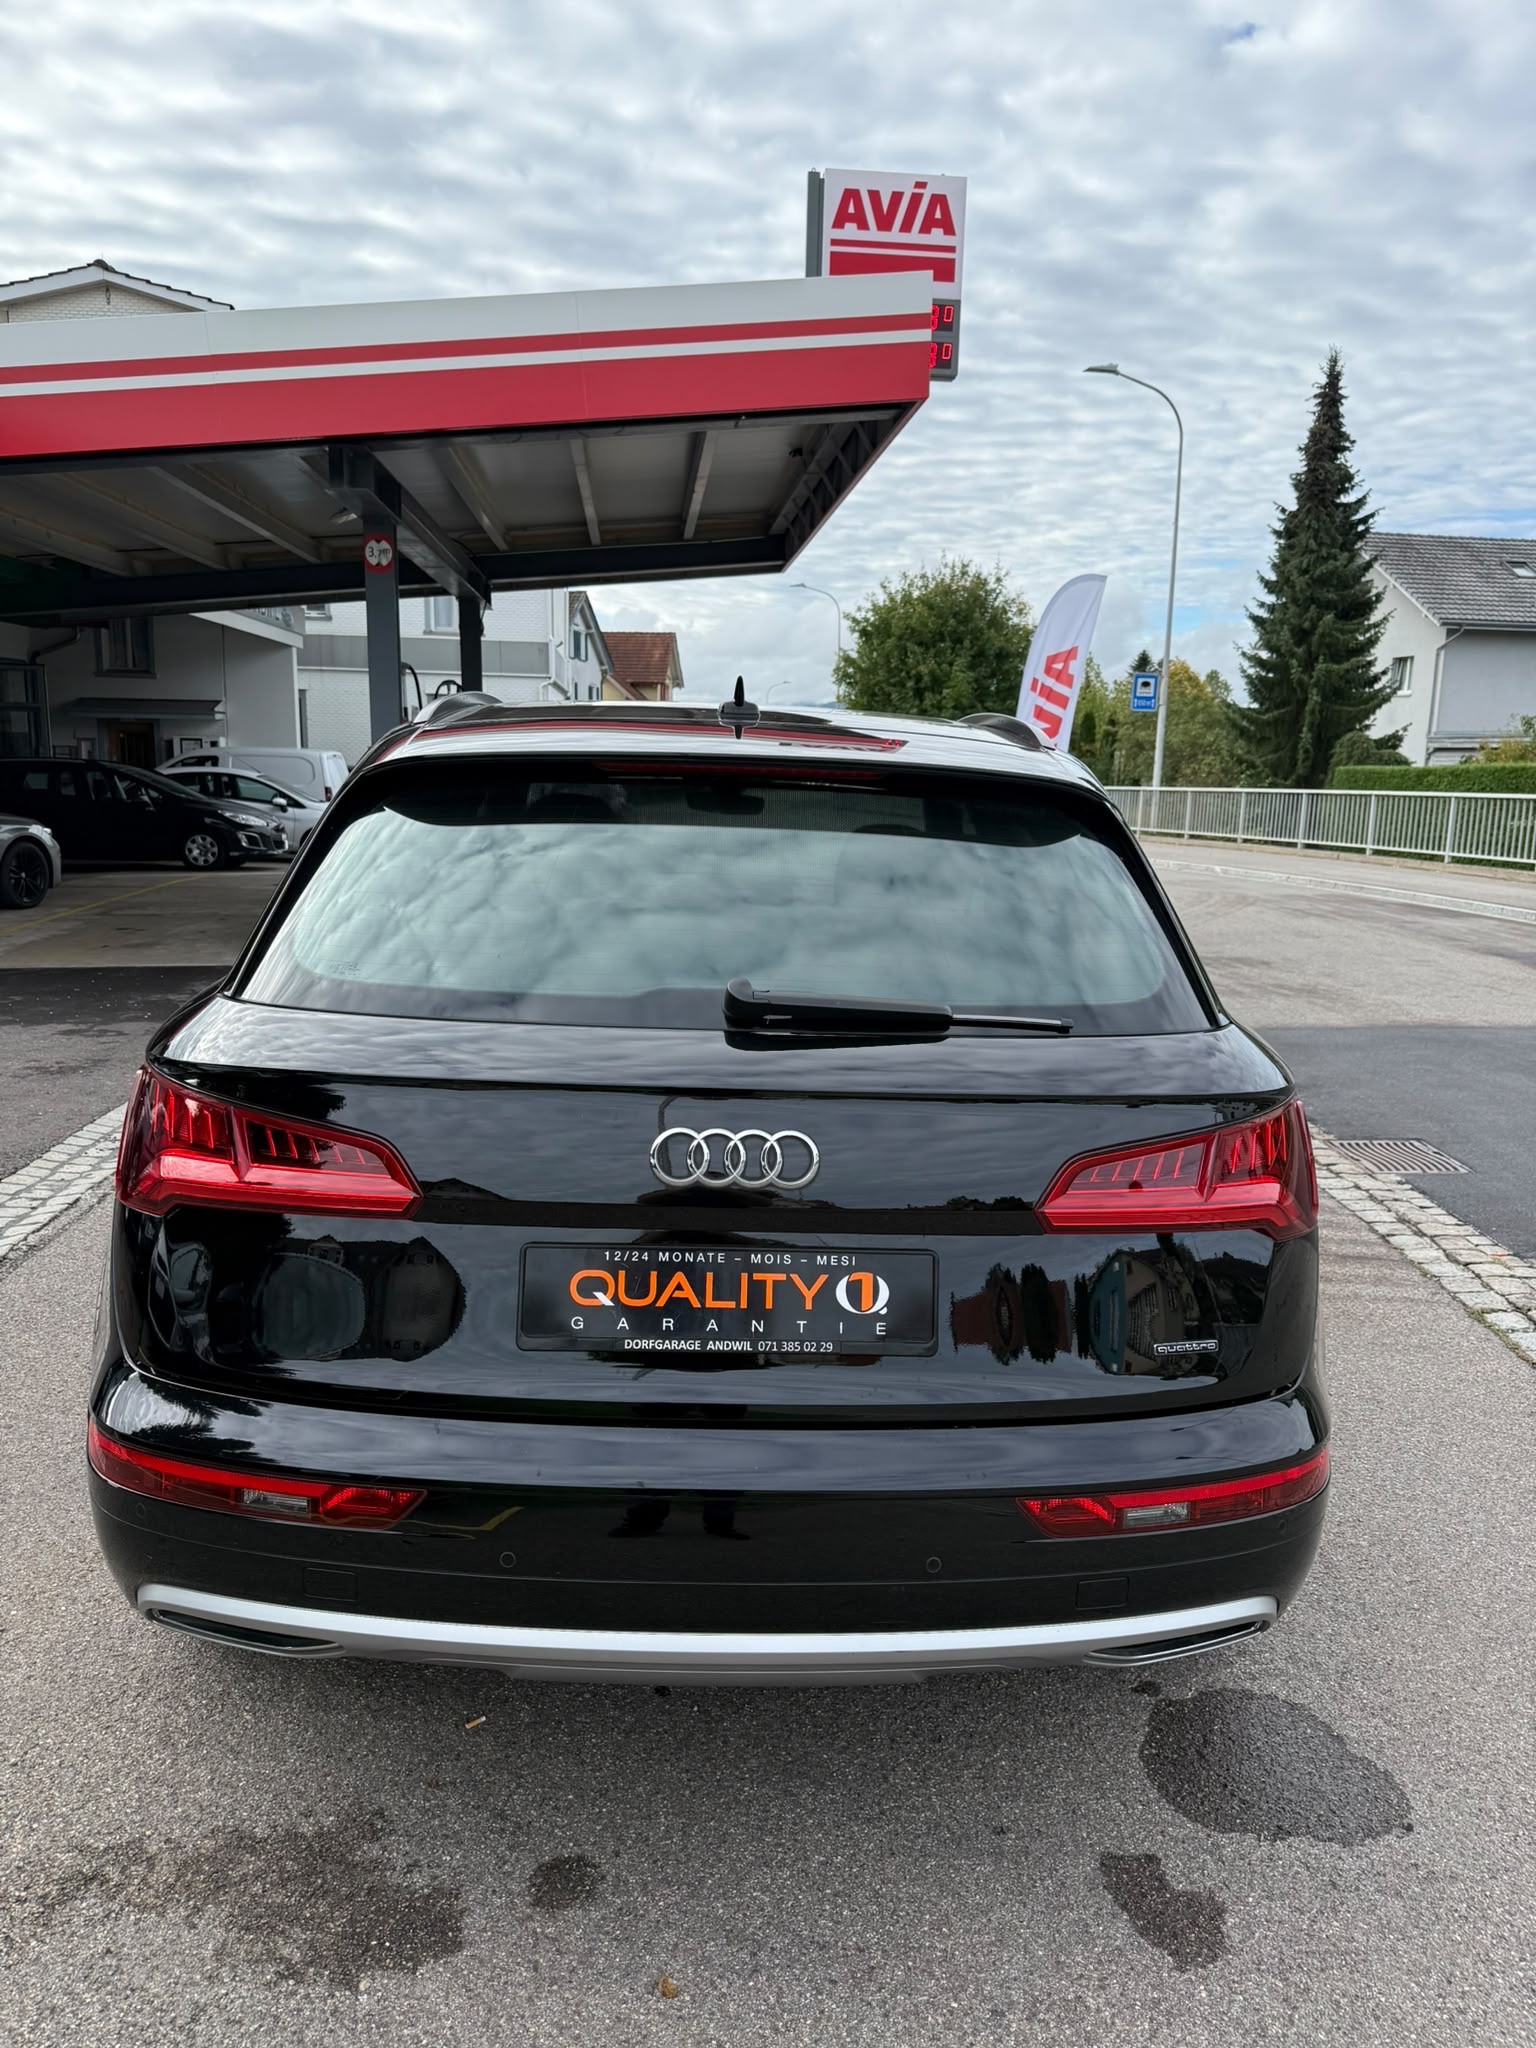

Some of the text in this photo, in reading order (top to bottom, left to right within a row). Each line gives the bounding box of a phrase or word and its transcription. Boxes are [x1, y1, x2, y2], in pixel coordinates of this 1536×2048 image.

[604, 1251, 649, 1262] 12/24
[658, 1252, 726, 1263] MONATE
[750, 1253, 792, 1265] MOIS
[816, 1255, 856, 1266] MESI
[569, 1269, 830, 1311] QUALITY
[570, 1316, 887, 1336] GARANTIE
[624, 1339, 833, 1352] DORFGARAGE ANDWIL 071 385 02 29
[1157, 1343, 1216, 1354] quattro
